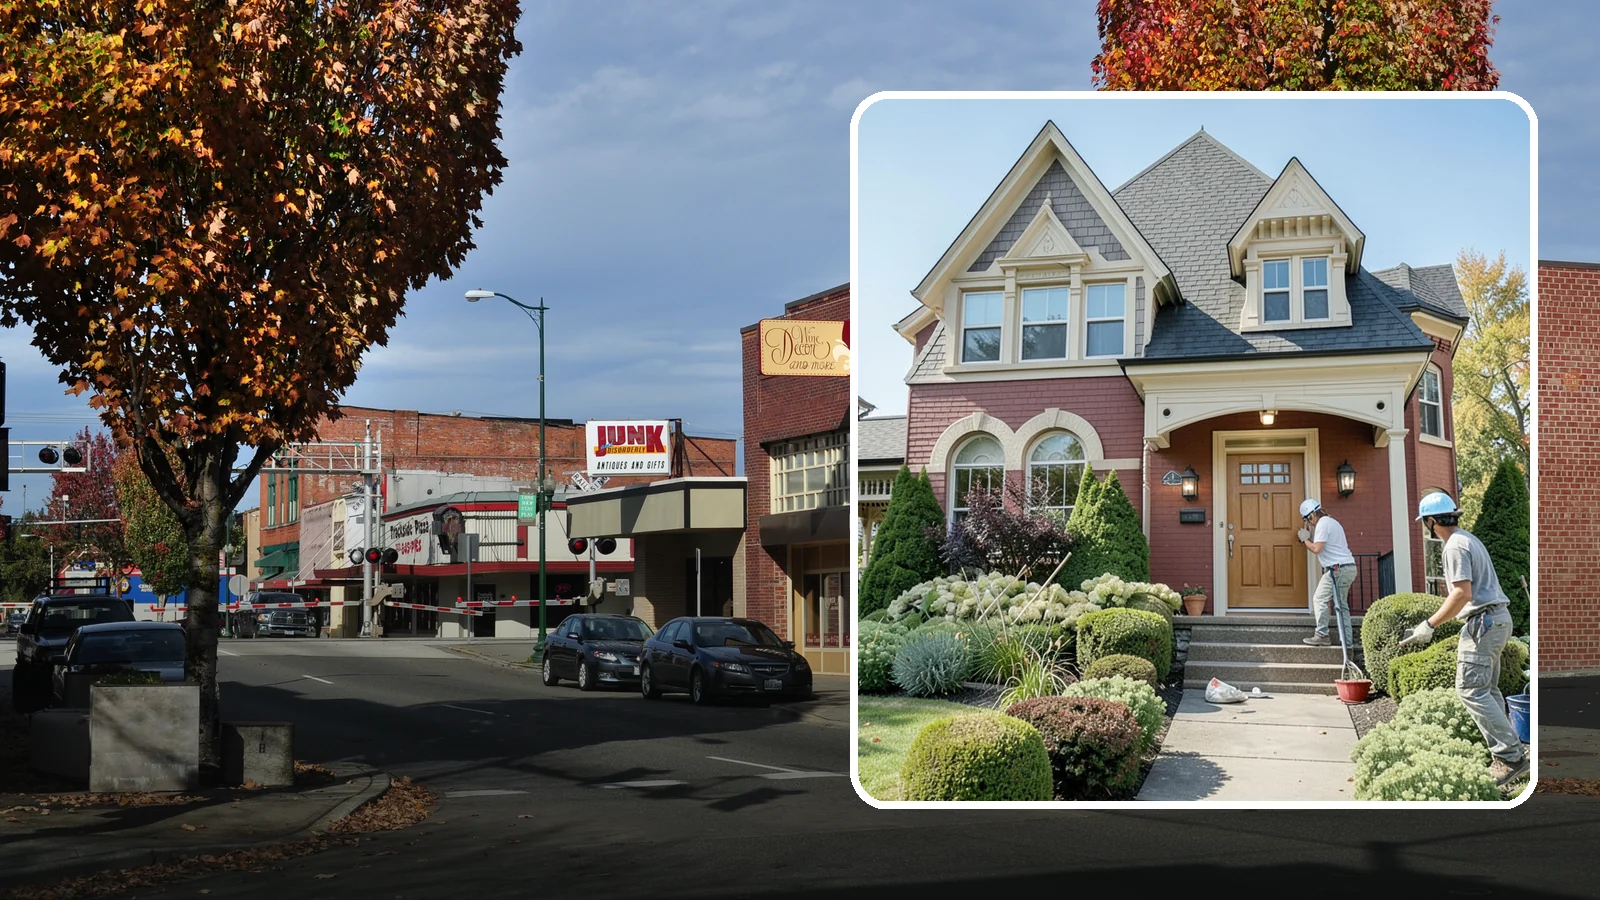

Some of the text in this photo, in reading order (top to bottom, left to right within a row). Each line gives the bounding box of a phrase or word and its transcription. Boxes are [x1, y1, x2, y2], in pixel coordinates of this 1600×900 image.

[595, 425, 665, 457] JUNK
[608, 446, 646, 454] DISORDERLY
[597, 460, 665, 470] ANTIQUES AND GIFTS
[414, 519, 429, 535] Pizza
